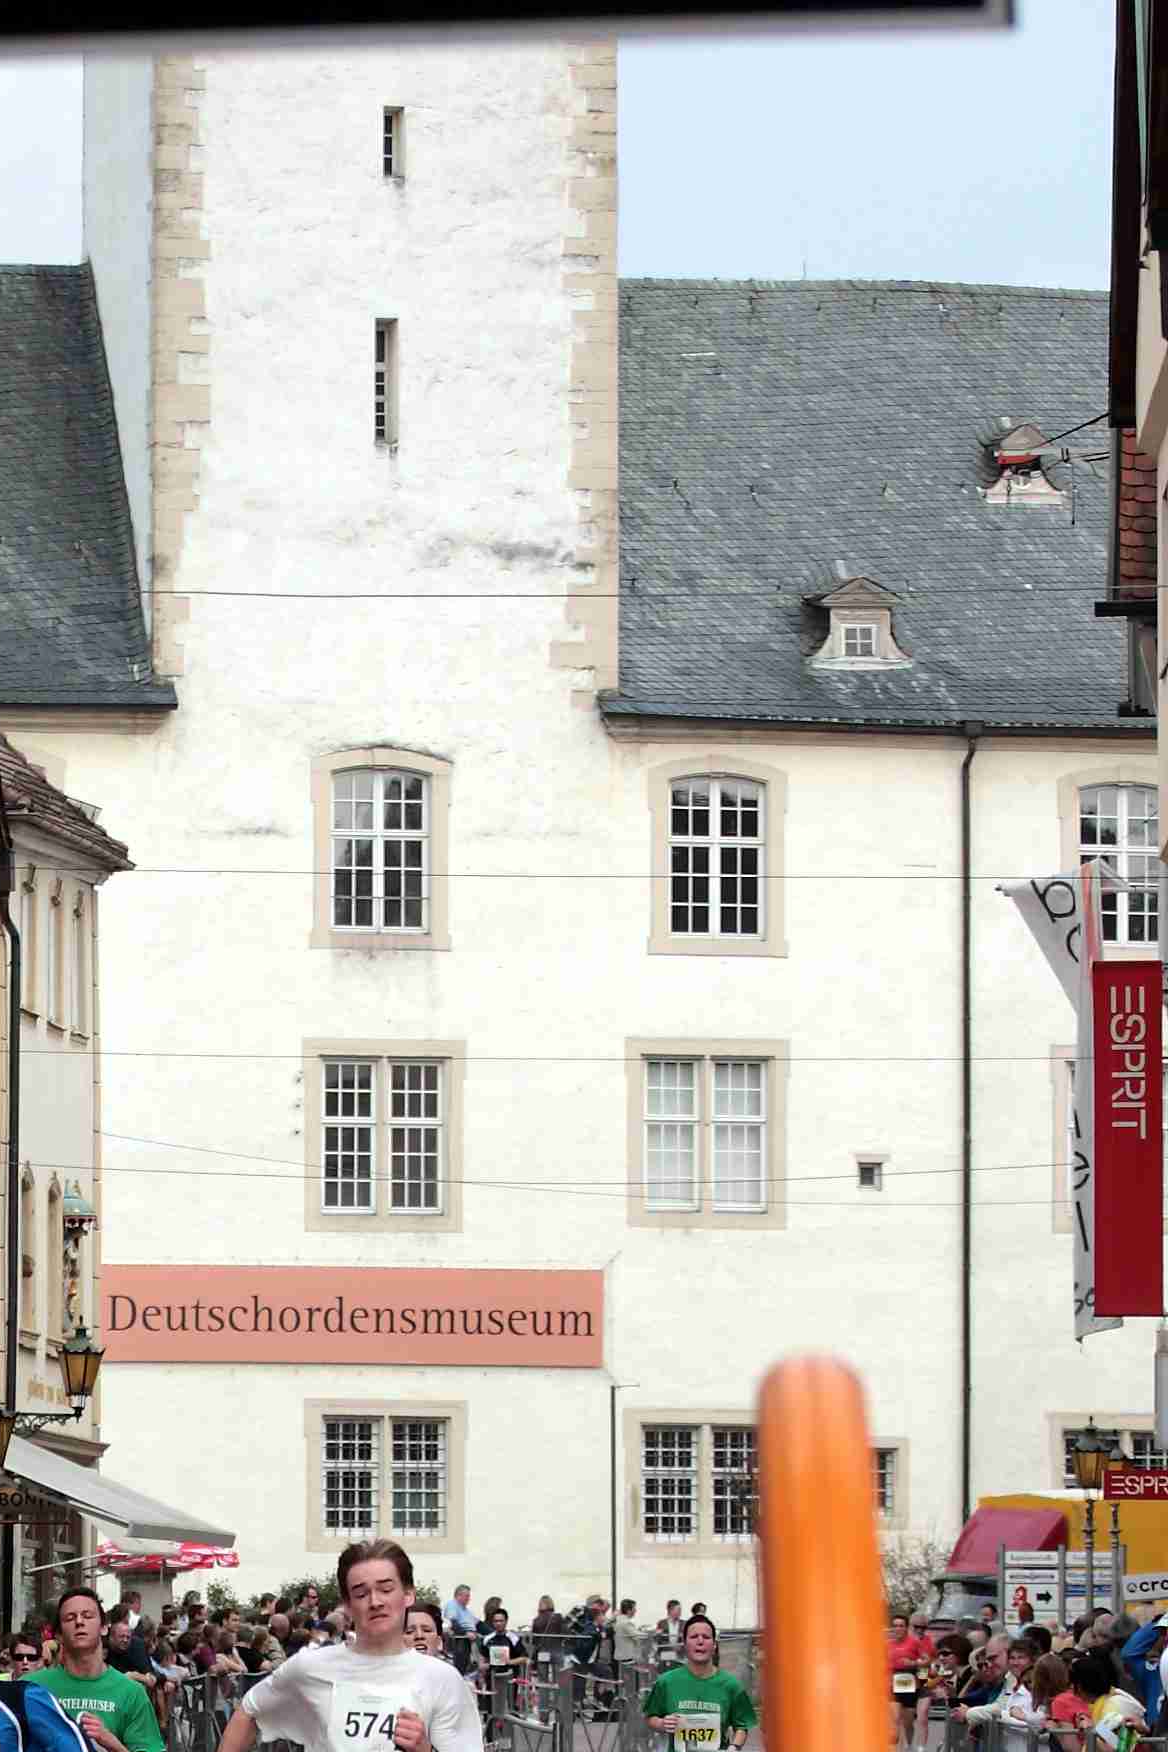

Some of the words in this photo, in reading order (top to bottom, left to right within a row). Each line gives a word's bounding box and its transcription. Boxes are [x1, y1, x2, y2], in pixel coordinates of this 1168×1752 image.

[1110, 986, 1146, 1139] ESPRIT
[107, 1294, 595, 1337] Deutschordensmuseum
[344, 1711, 395, 1740] 574
[680, 1728, 714, 1742] 1637
